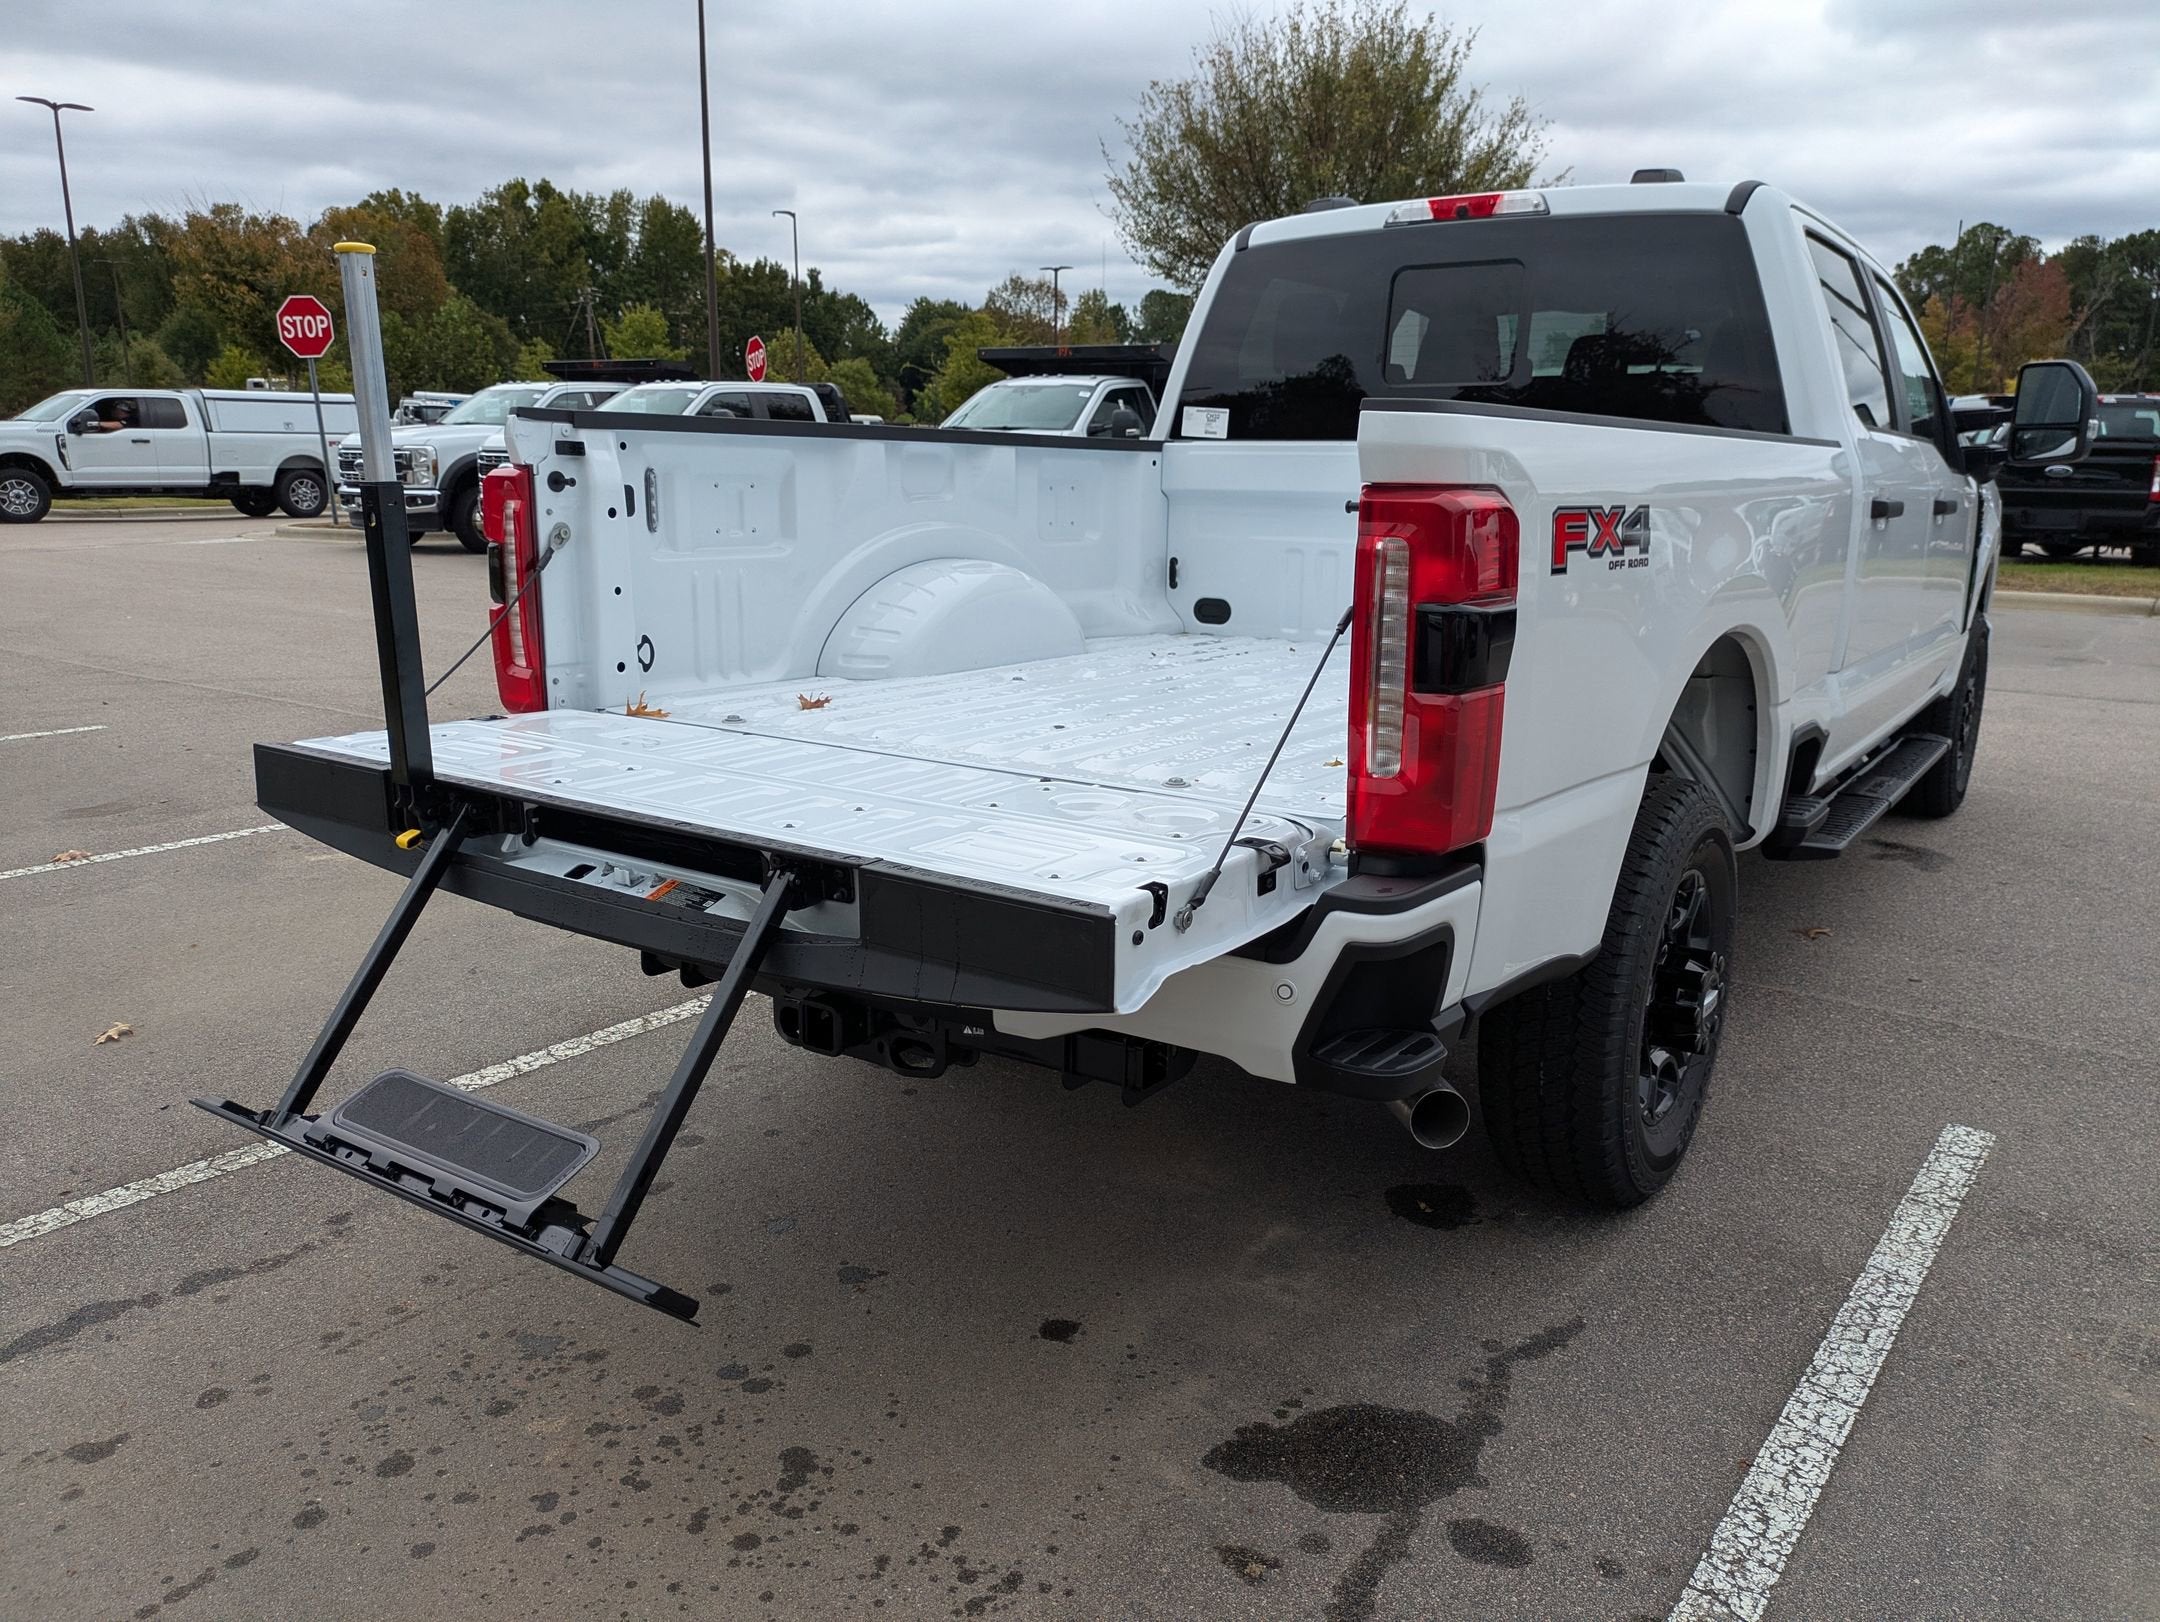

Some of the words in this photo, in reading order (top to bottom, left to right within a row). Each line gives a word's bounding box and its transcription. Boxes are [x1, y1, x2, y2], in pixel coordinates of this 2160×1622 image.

[282, 315, 328, 338] STOP
[748, 348, 764, 371] STOP
[1551, 505, 1650, 576] FX4
[1608, 559, 1626, 570] OFF
[1628, 558, 1649, 568] ROAD
